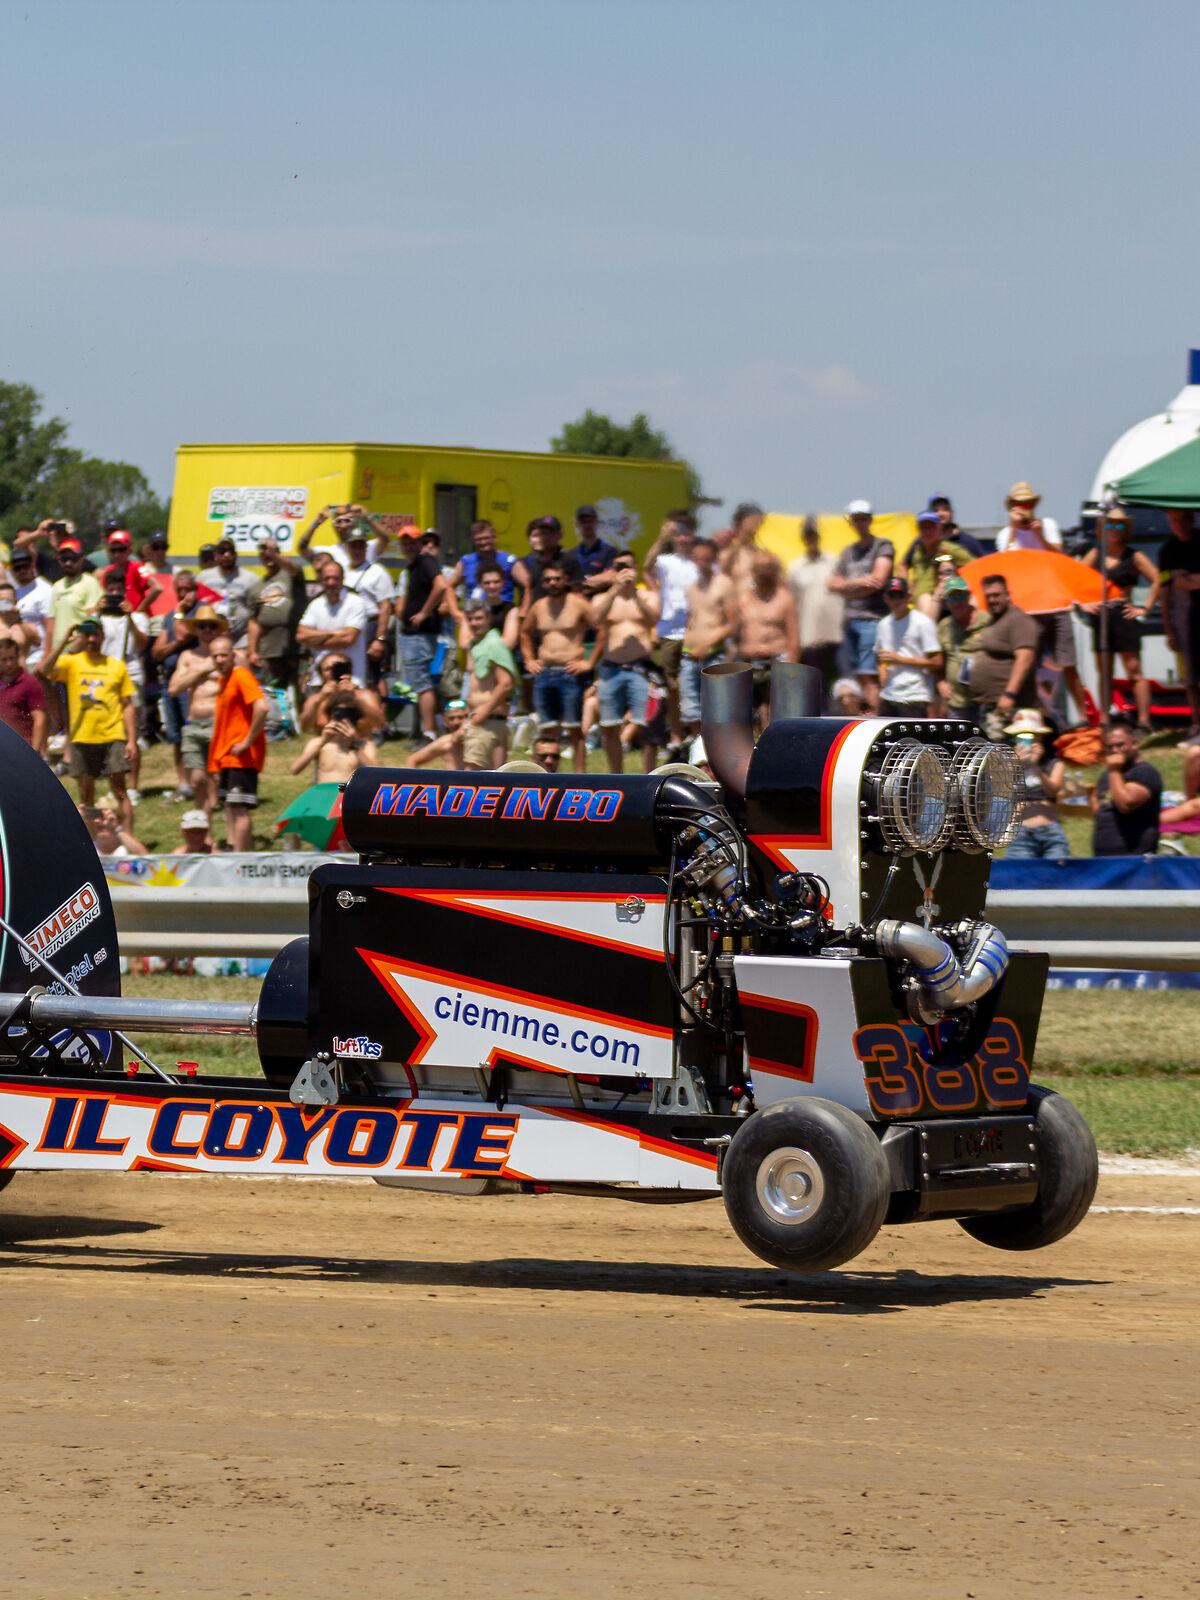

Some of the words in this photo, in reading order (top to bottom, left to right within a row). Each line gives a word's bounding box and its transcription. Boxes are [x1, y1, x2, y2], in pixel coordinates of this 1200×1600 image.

[368, 784, 505, 818] MADE
[501, 787, 559, 820] IN
[554, 788, 623, 822] BO
[27, 889, 94, 958] SIMECO
[333, 1037, 382, 1057] LuftPics
[434, 992, 640, 1066] ciemme.com
[852, 1017, 1031, 1115] 388
[33, 1093, 132, 1156] IL
[146, 1097, 521, 1176] COYOTE
